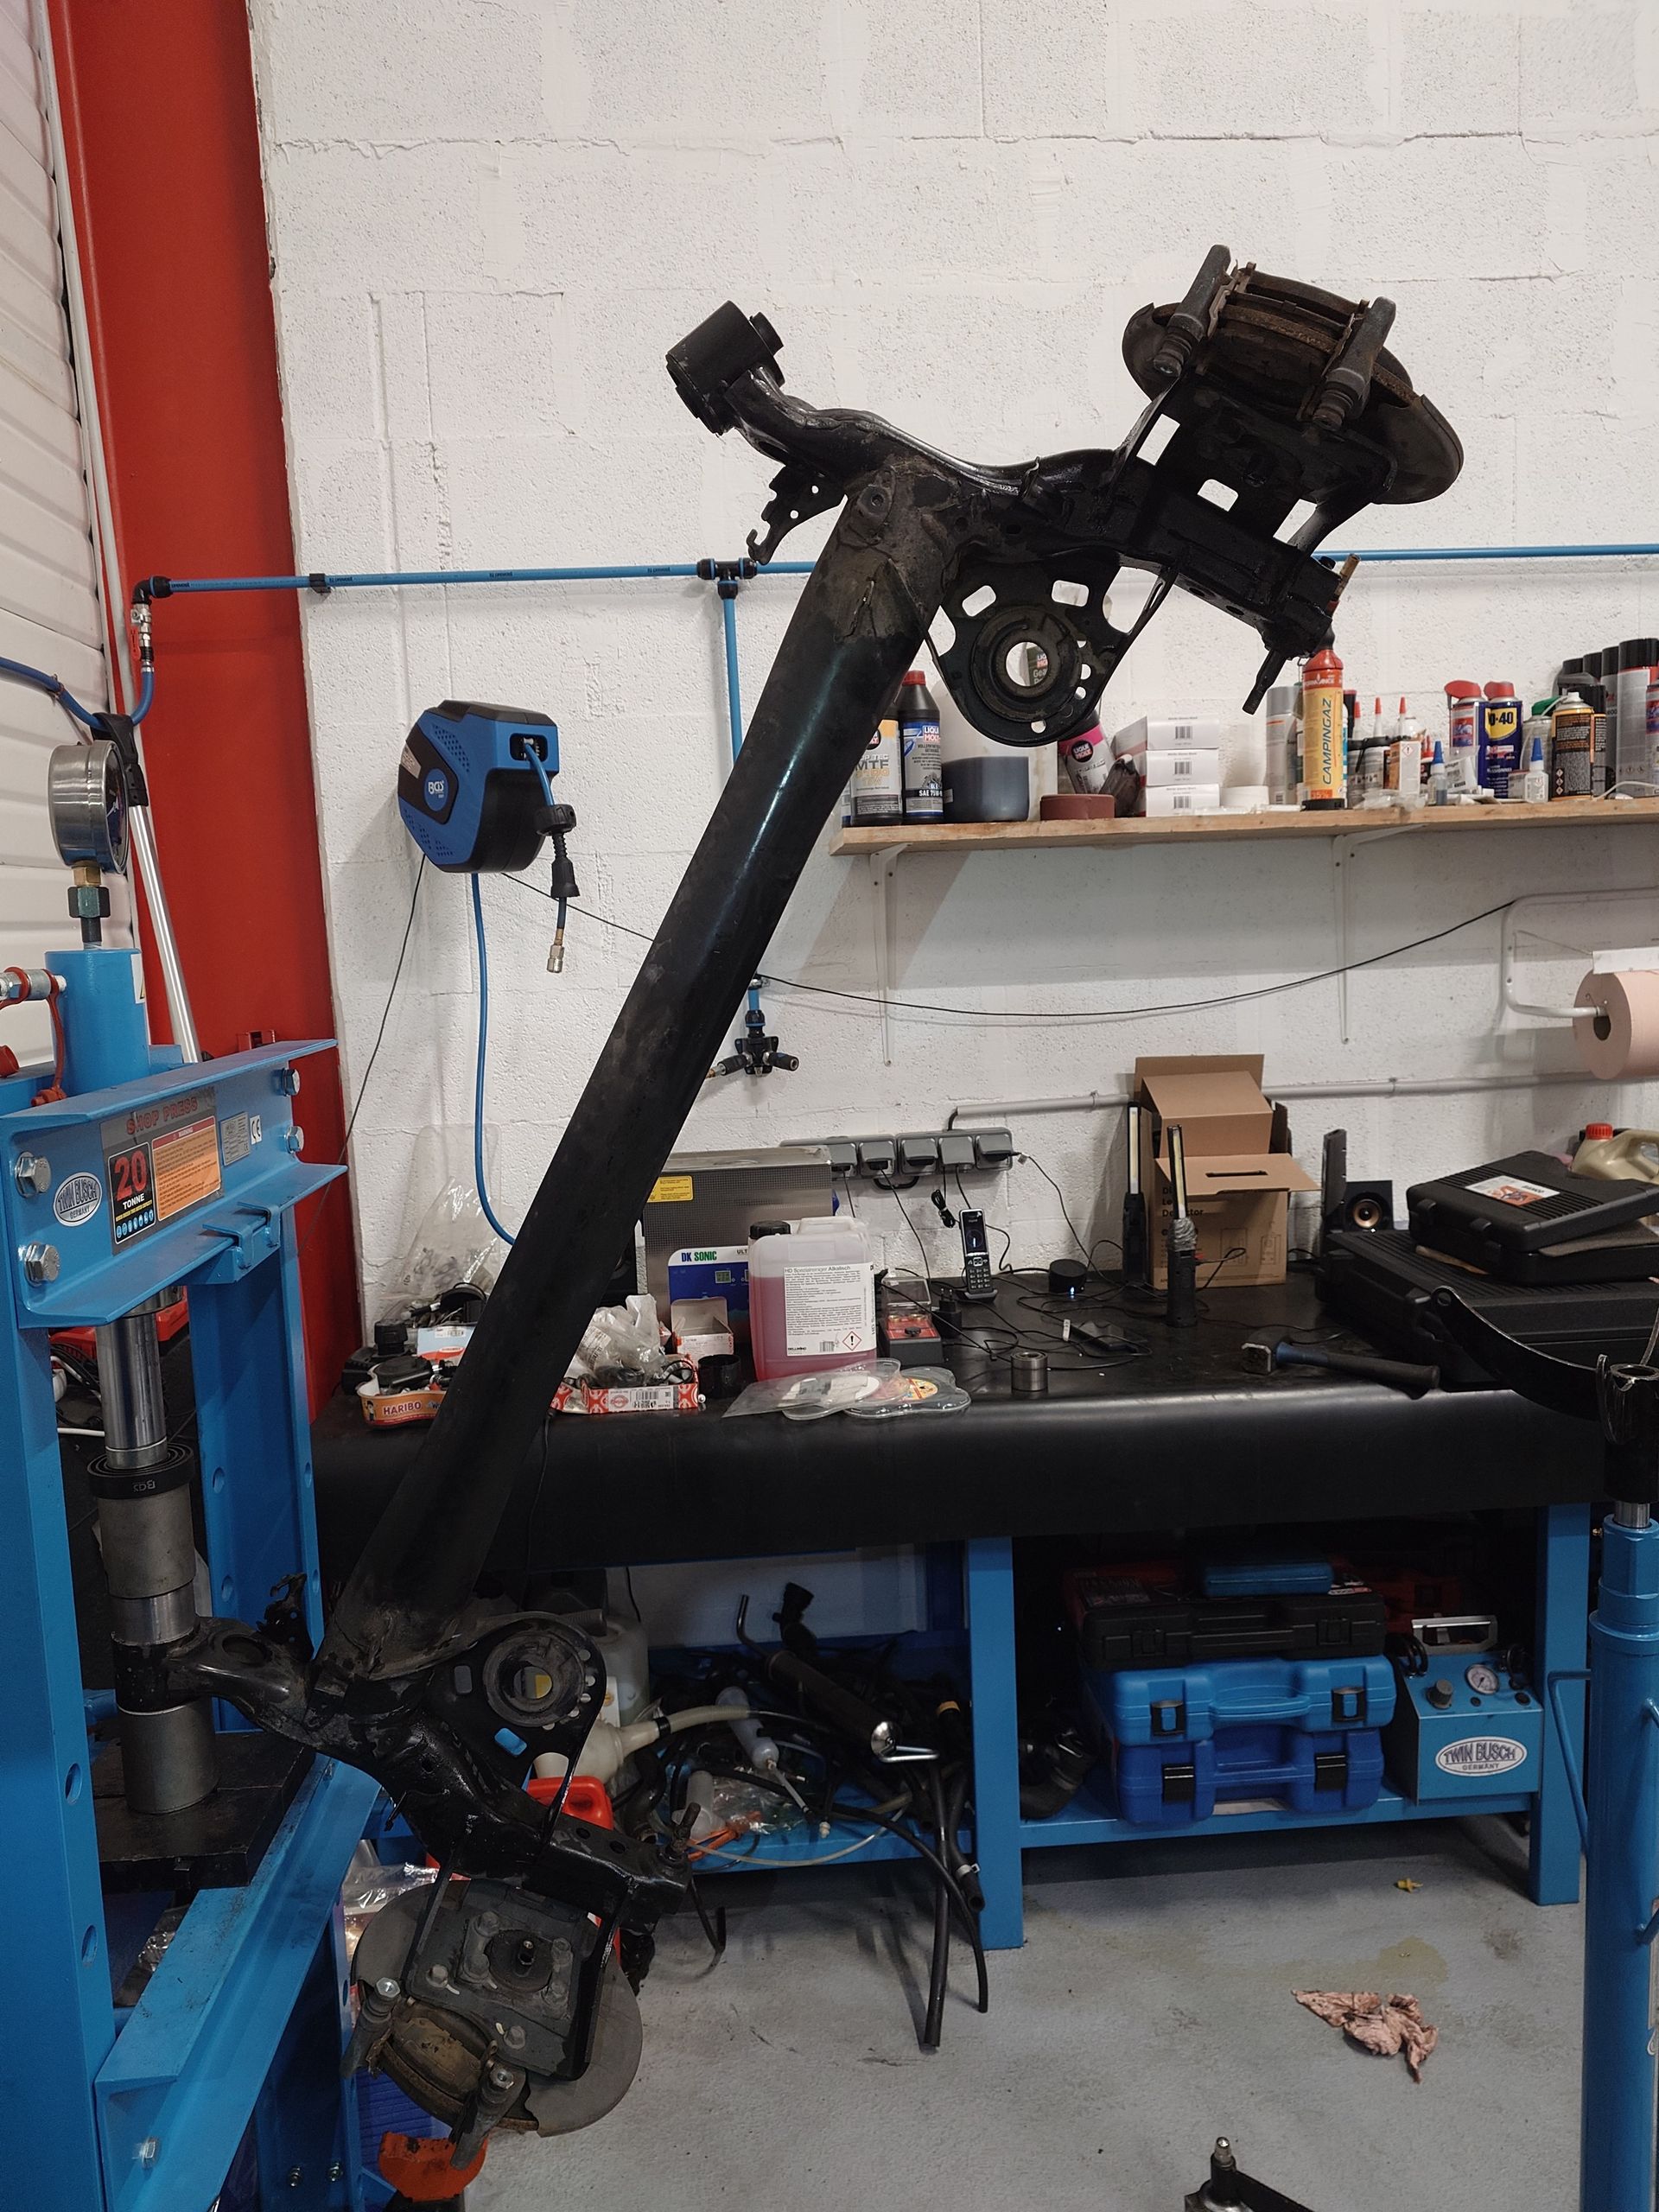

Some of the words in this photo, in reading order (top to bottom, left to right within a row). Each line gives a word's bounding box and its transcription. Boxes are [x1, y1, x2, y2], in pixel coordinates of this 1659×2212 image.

[1322, 698, 1332, 785] CAMPINGAZ
[126, 1109, 159, 1135] SHOP
[162, 1096, 199, 1122] PRESS
[114, 1149, 147, 1201] 20
[58, 1183, 76, 1211] TWIN
[74, 1179, 99, 1205] BUSCH
[123, 1192, 145, 1210] TONNE
[681, 1252, 692, 1262] DK
[694, 1251, 717, 1262] SONIC
[384, 1402, 422, 1415] HARIBO
[1444, 1744, 1473, 1763] TWIN
[1476, 1742, 1516, 1761] BUSCH
